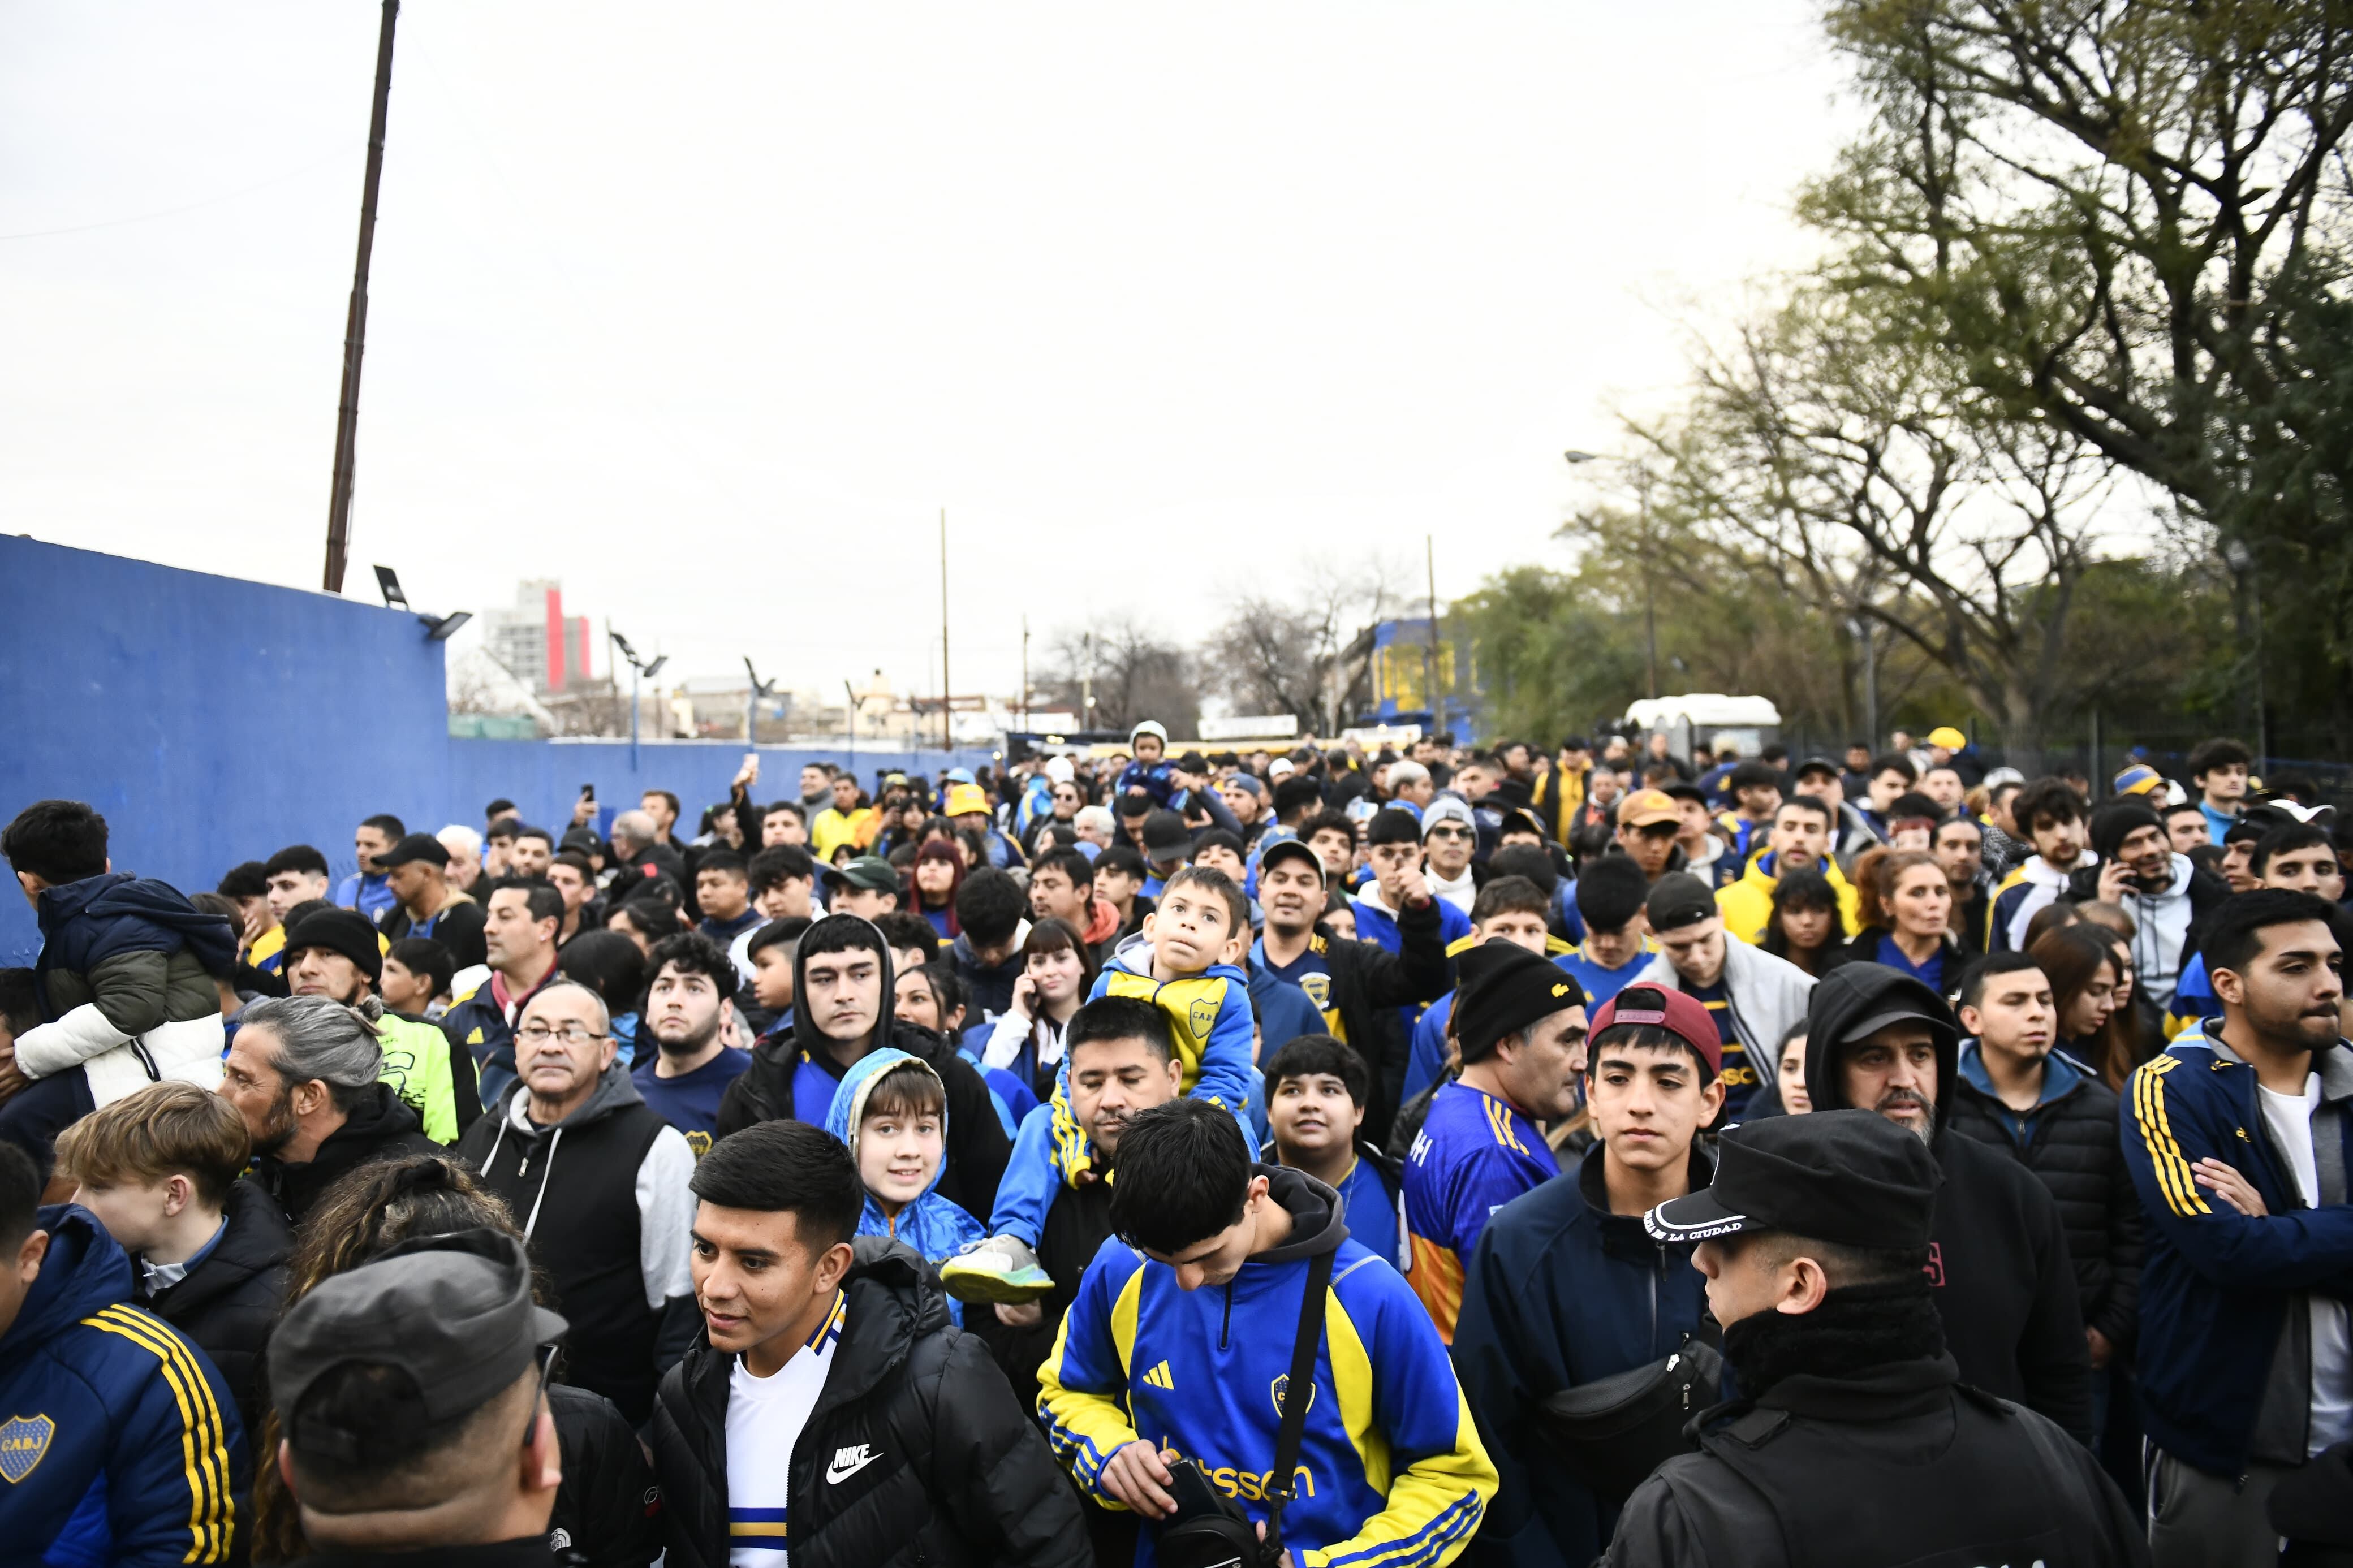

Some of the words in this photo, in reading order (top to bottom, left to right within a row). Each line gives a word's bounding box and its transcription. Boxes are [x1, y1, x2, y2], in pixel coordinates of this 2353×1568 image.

[1193, 1011, 1214, 1022] CAB
[1667, 1233, 1685, 1241] LA
[1688, 1222, 1742, 1240] CIUDAD
[1, 1436, 43, 1452] CABJ
[833, 1443, 870, 1469] NIKE
